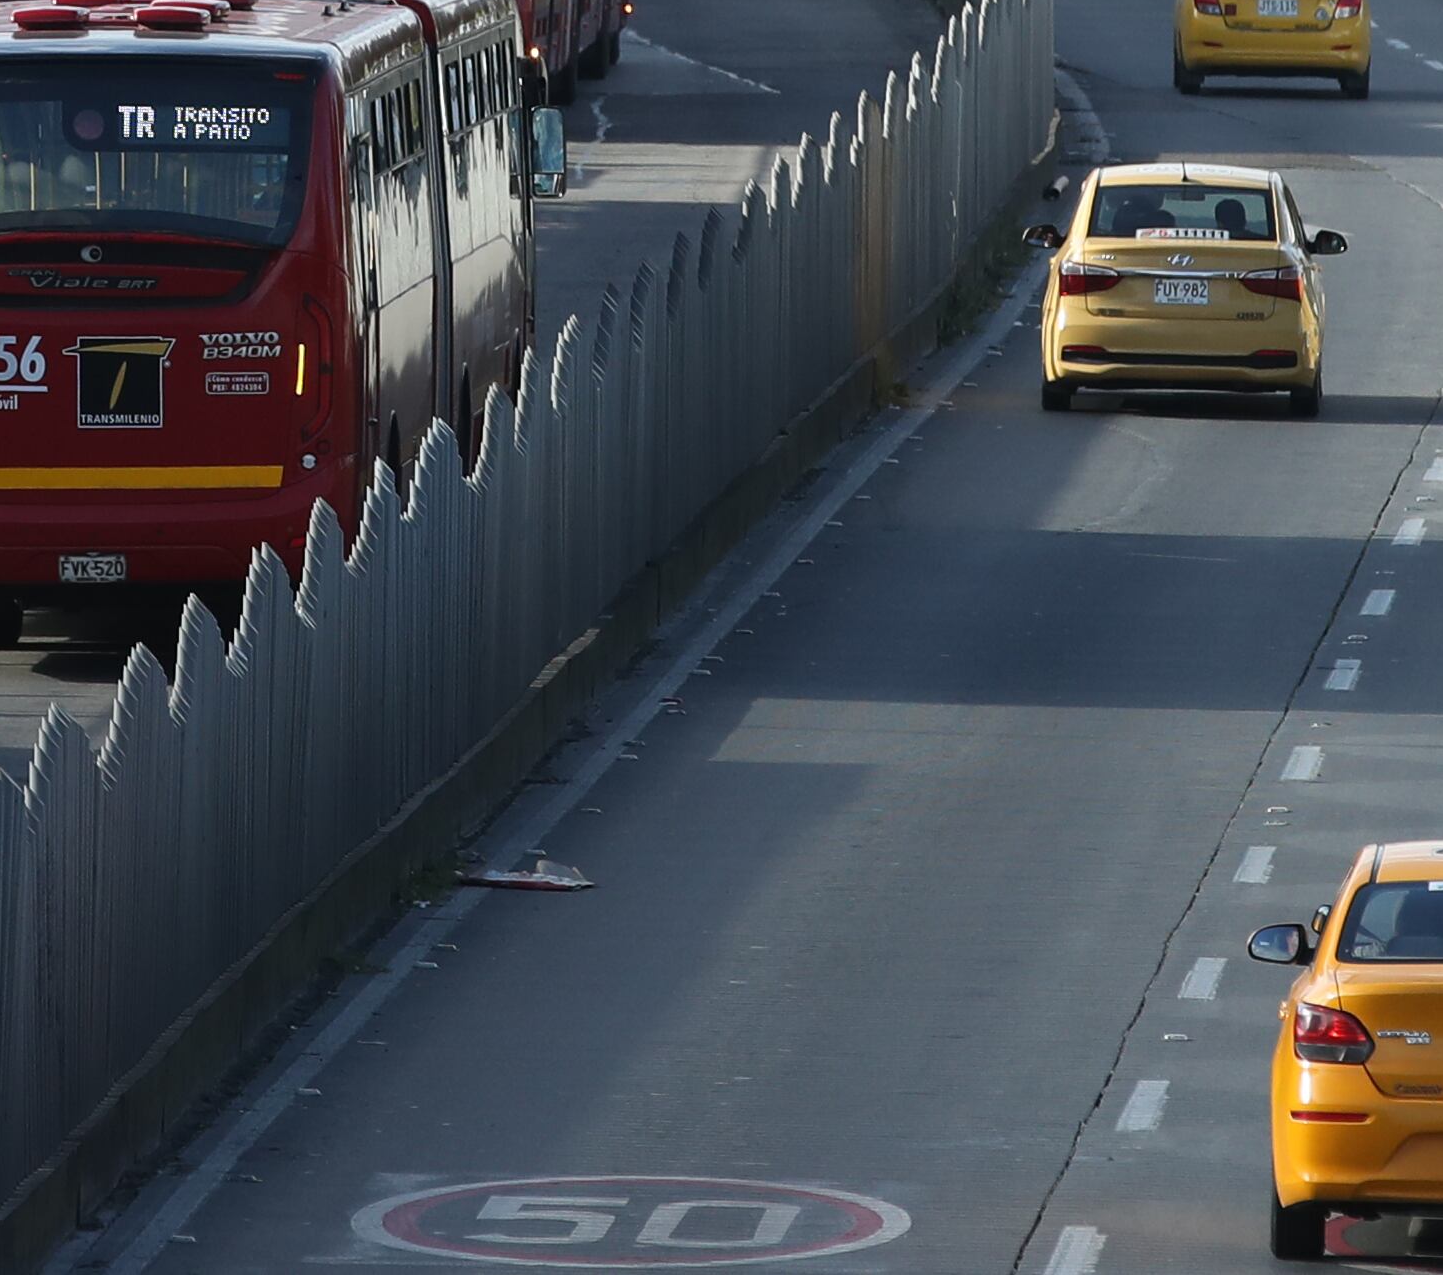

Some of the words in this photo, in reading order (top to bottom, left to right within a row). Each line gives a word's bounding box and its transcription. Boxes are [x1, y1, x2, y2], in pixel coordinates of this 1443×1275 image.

[118, 105, 155, 138] TR
[174, 106, 270, 124] TRANSITO
[173, 123, 187, 139] A
[194, 123, 251, 140] PATIO
[30, 276, 109, 288] Viale
[117, 280, 157, 289] BRT
[199, 331, 279, 345] VOLVO
[203, 345, 282, 360] B340M
[80, 413, 160, 424] TRANSMILENIO
[60, 560, 124, 577] FVK-520
[463, 1196, 801, 1248] 50
